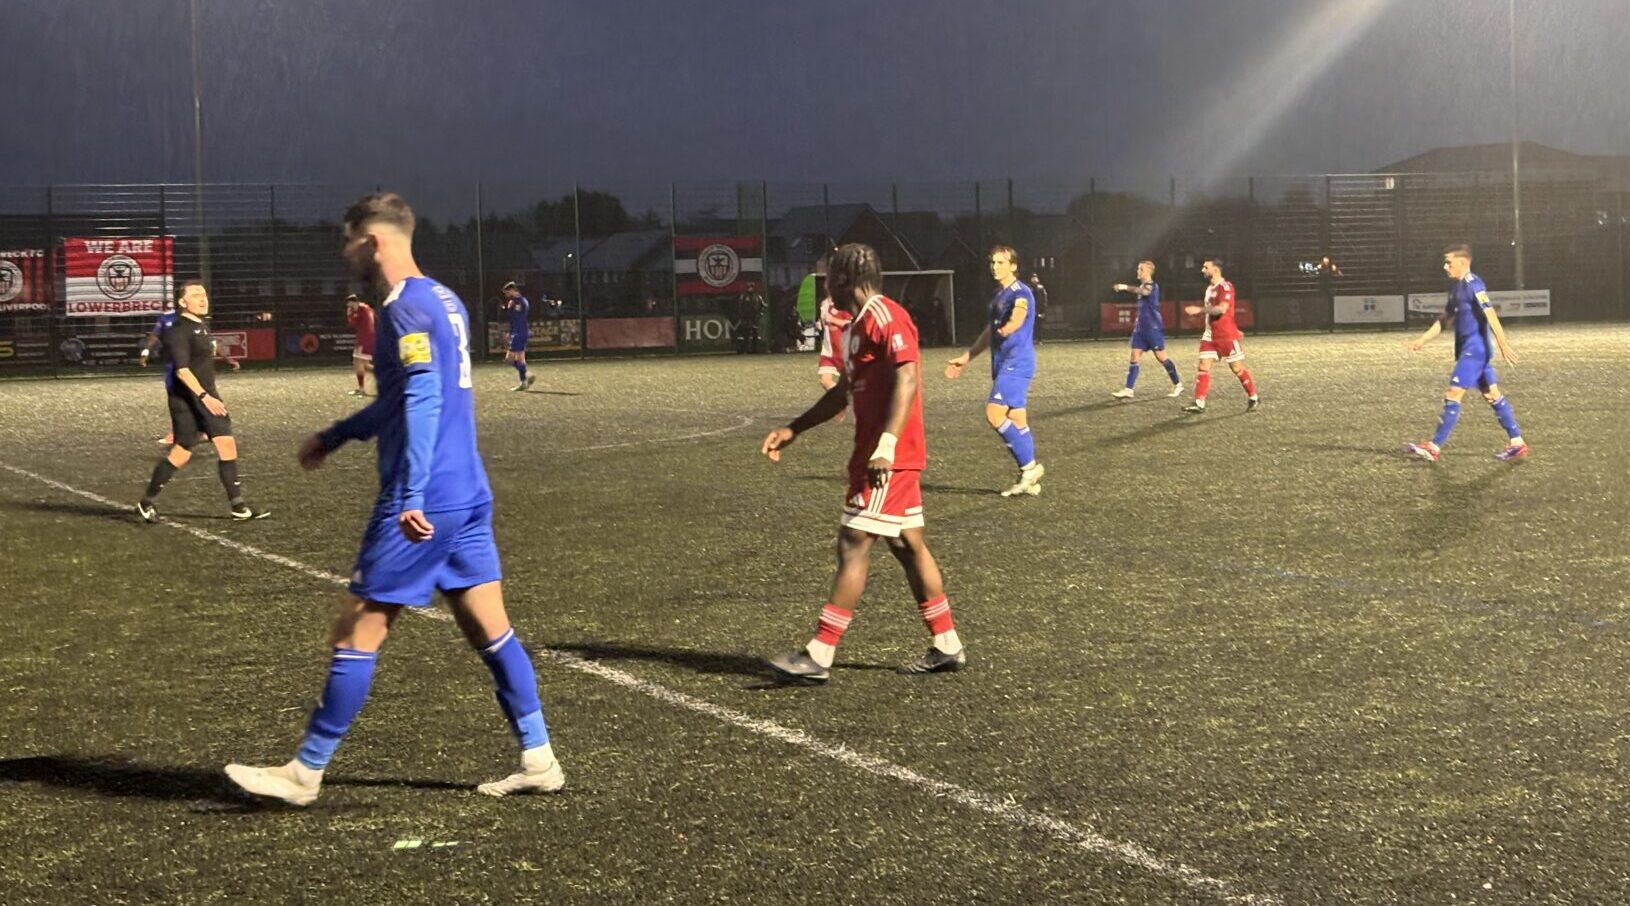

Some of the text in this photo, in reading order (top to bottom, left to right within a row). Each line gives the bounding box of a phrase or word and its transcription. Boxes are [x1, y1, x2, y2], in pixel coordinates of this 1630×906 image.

[84, 240, 154, 254] WE ARE
[67, 301, 173, 314] LOWERBRECK
